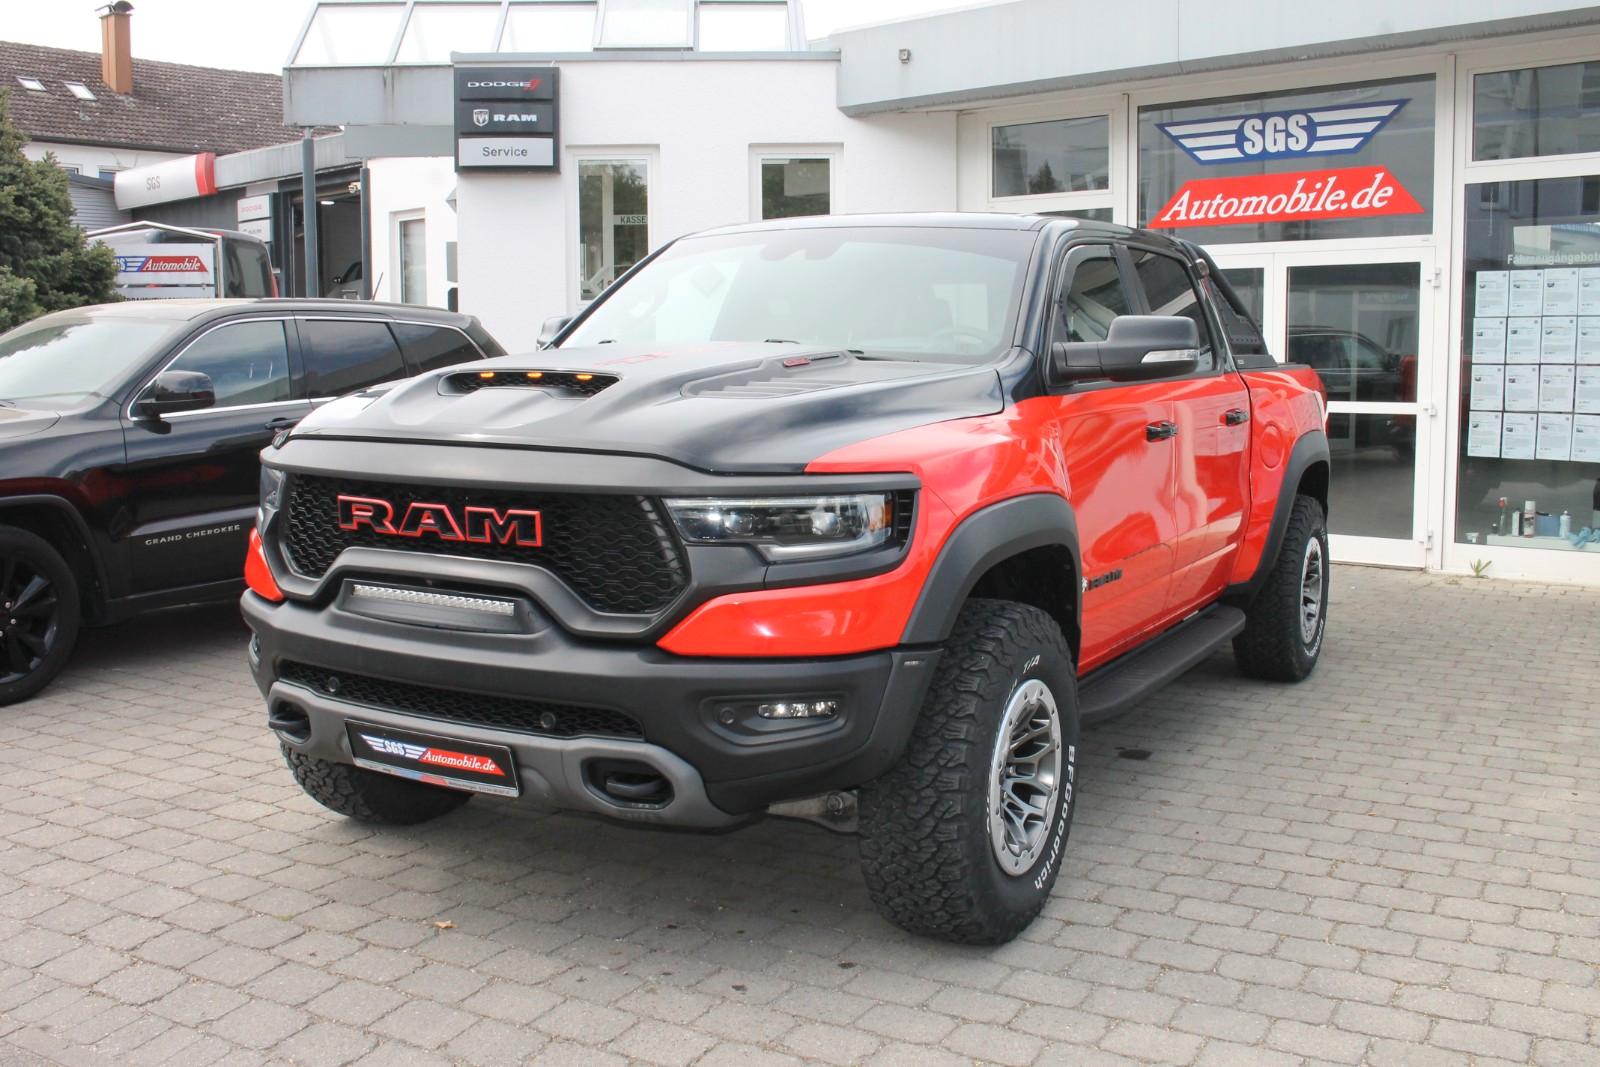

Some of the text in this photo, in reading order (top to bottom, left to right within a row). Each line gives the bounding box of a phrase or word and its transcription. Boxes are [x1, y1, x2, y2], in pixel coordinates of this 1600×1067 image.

[493, 114, 538, 122] RAM
[1243, 113, 1309, 155] SGS
[482, 146, 528, 157] Service
[146, 176, 161, 190] SGS
[1161, 172, 1394, 222] Automobile.de
[620, 215, 647, 224] KASSE
[143, 258, 200, 271] Automobile
[337, 495, 542, 547] RAM
[145, 524, 240, 545] GRAND CHEROKEE
[384, 740, 496, 772] SGS Automobile.de
[1034, 744, 1076, 890] BFGoodrich
